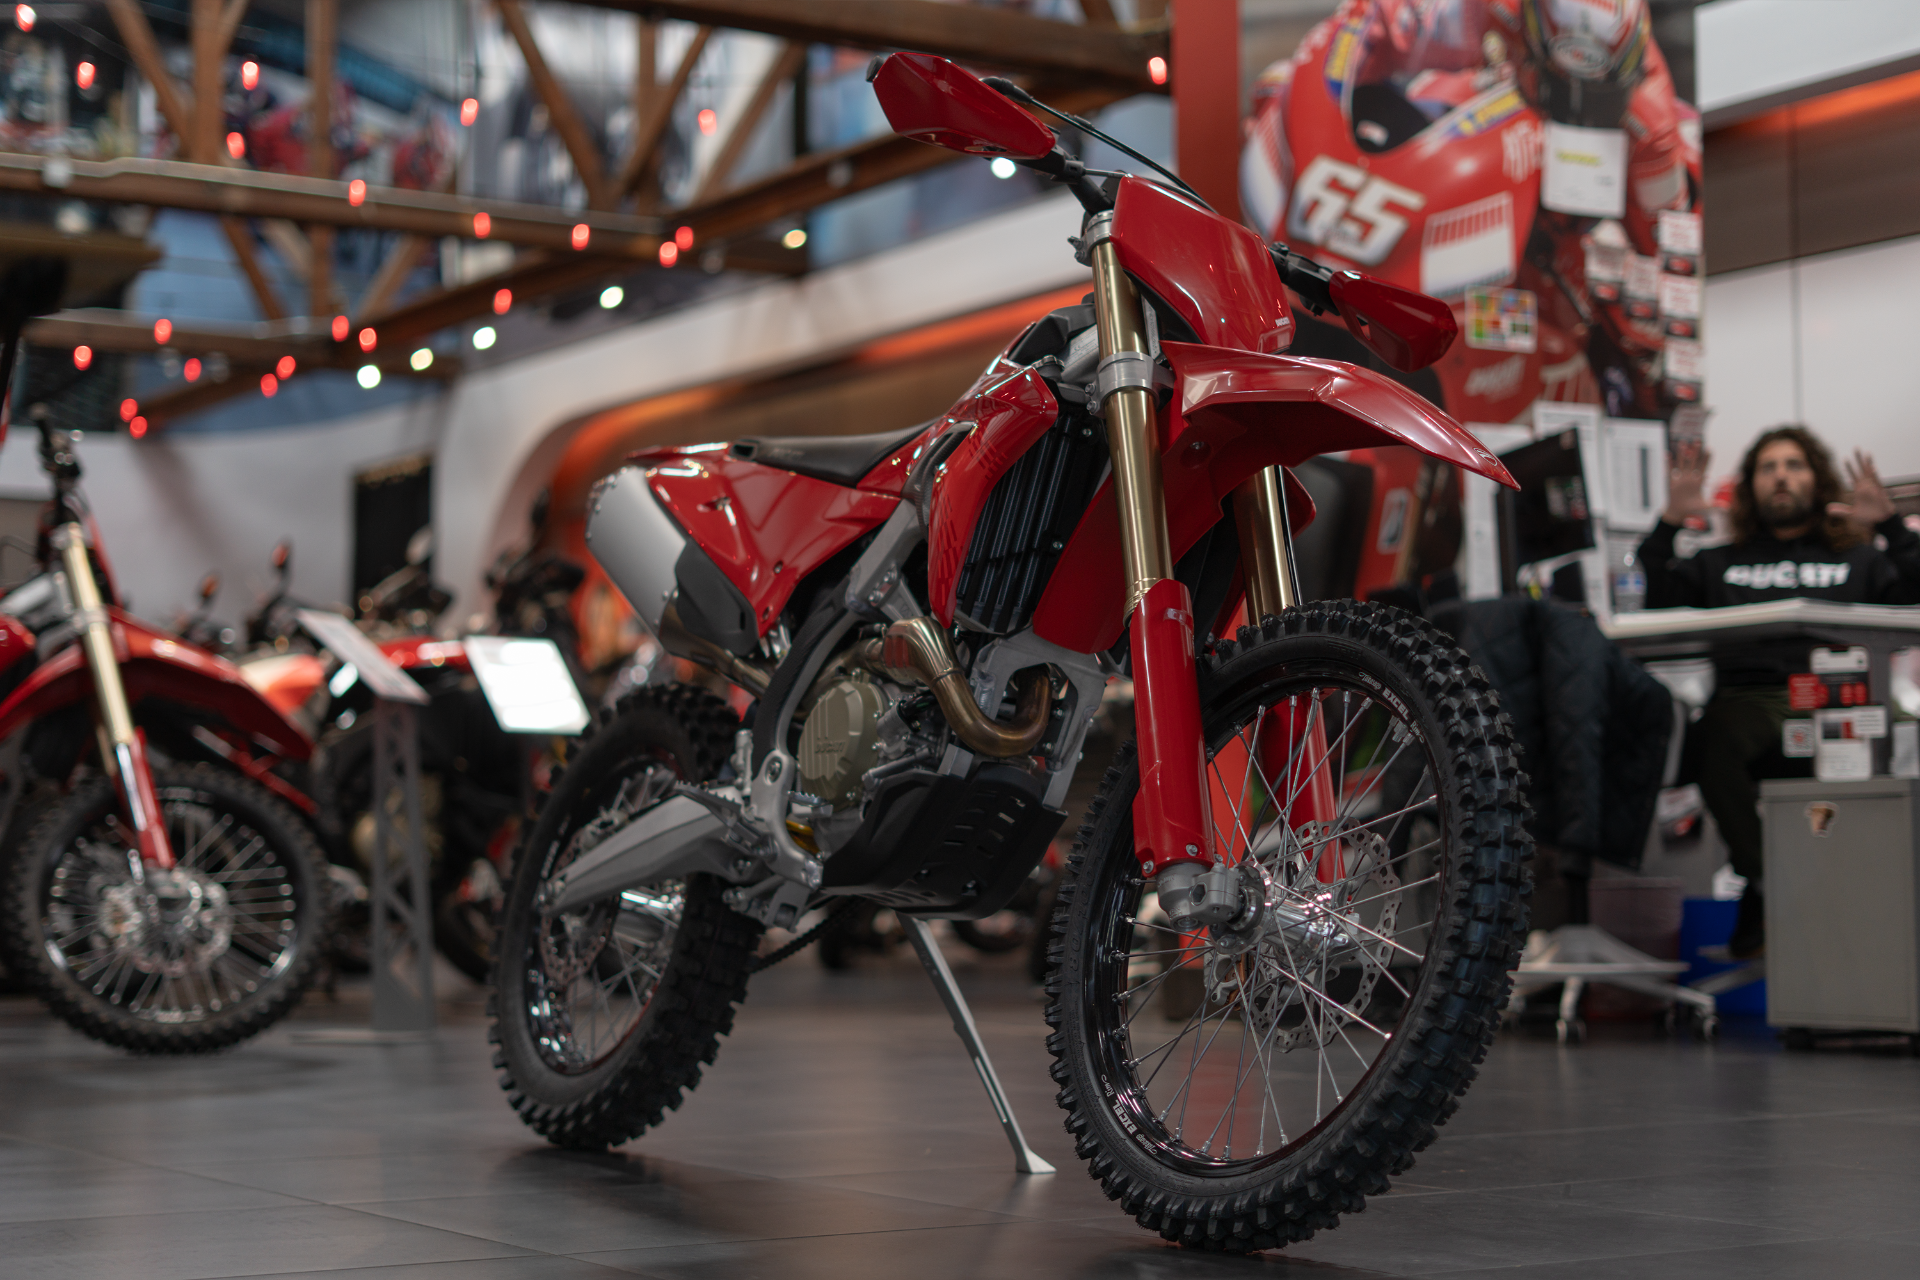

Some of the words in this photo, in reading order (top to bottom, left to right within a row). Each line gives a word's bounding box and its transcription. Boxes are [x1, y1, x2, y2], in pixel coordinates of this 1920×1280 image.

[1289, 156, 1427, 267] 65
[1723, 560, 1850, 589] DUCATI
[1382, 687, 1409, 720] EXCEL
[1112, 1099, 1138, 1134] EXCEL
